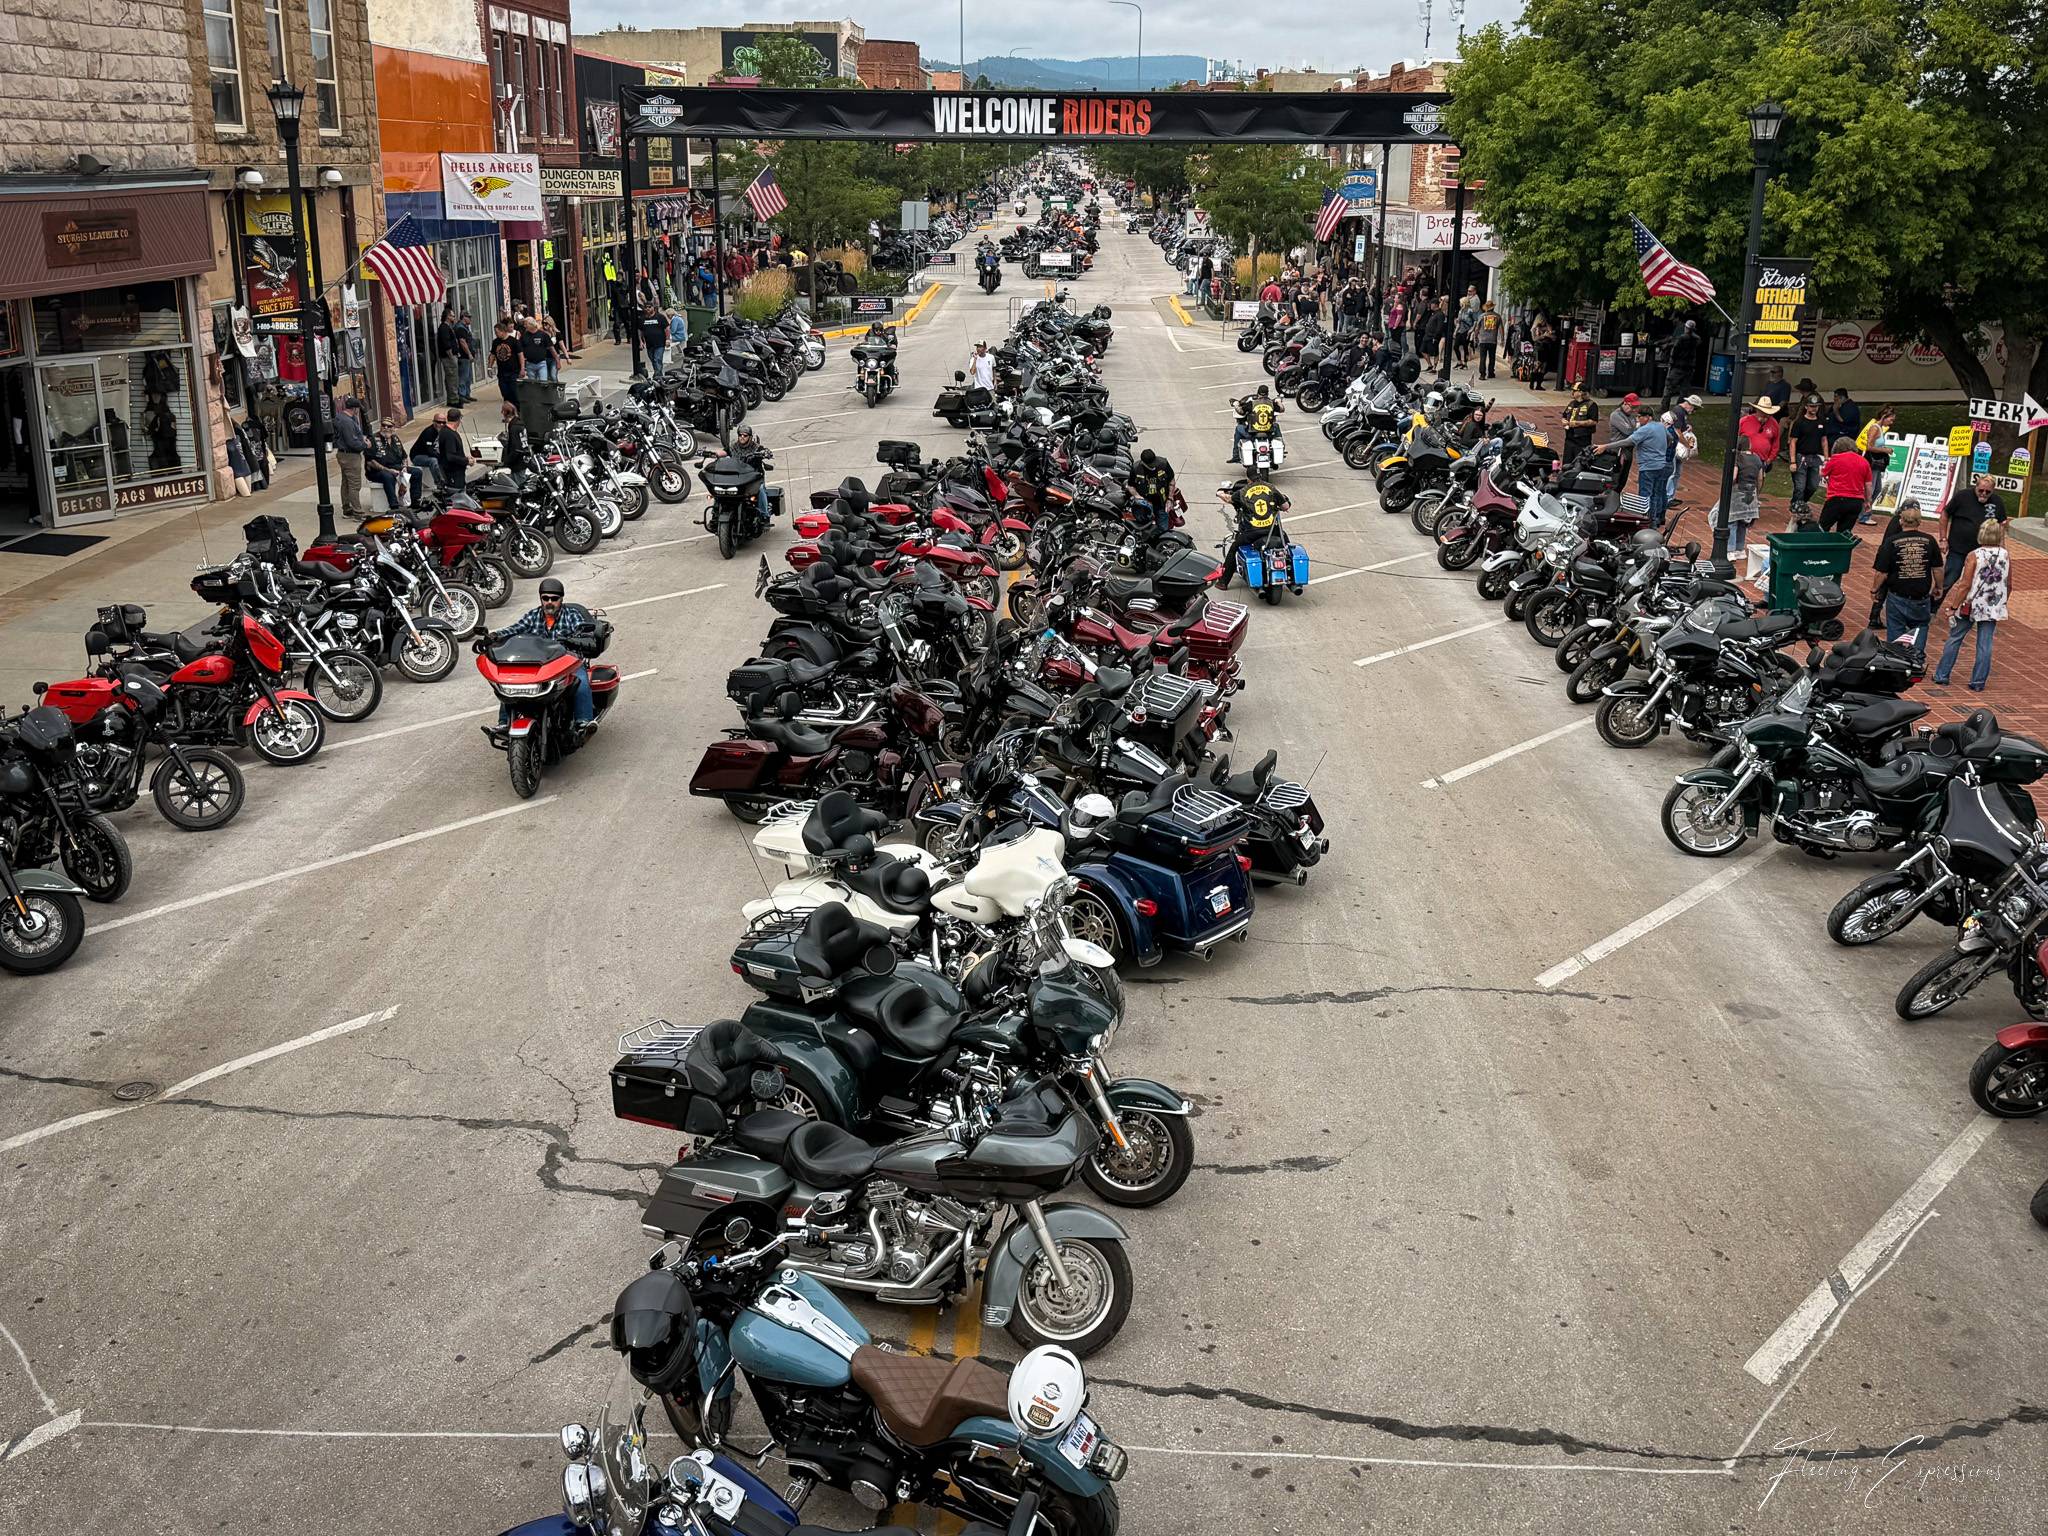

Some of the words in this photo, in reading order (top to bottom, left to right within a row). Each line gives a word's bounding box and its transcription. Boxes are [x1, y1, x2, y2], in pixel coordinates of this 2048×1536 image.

[933, 97, 1056, 134] WELCOME
[1063, 99, 1152, 135] RIDERS
[450, 161, 485, 173] HELLS
[489, 162, 534, 174] ANGELS
[540, 169, 594, 180] DUNGEON
[598, 171, 620, 180] BAR
[545, 181, 616, 190] DOWNSTAIRS
[262, 214, 293, 224] BIKER
[267, 222, 287, 230] LIFE
[57, 232, 88, 244] STURGIS
[89, 230, 120, 241] LEATHER
[1432, 233, 1453, 246] All
[1460, 233, 1483, 246] Day
[1759, 269, 1807, 289] Sturgis
[1755, 288, 1805, 305] OFFICIAL
[259, 303, 279, 313] SINCE
[280, 301, 294, 311] 1975
[1761, 305, 1796, 320] RALLY
[1910, 343, 1944, 357] Mack
[1971, 400, 2038, 422] JERKY
[1971, 421, 1990, 432] FREE
[2010, 459, 2029, 467] JERKY
[1973, 474, 2018, 489] SKED
[62, 496, 102, 513] BELTS
[114, 489, 146, 506] BAGS
[153, 480, 205, 498] WALLETS
